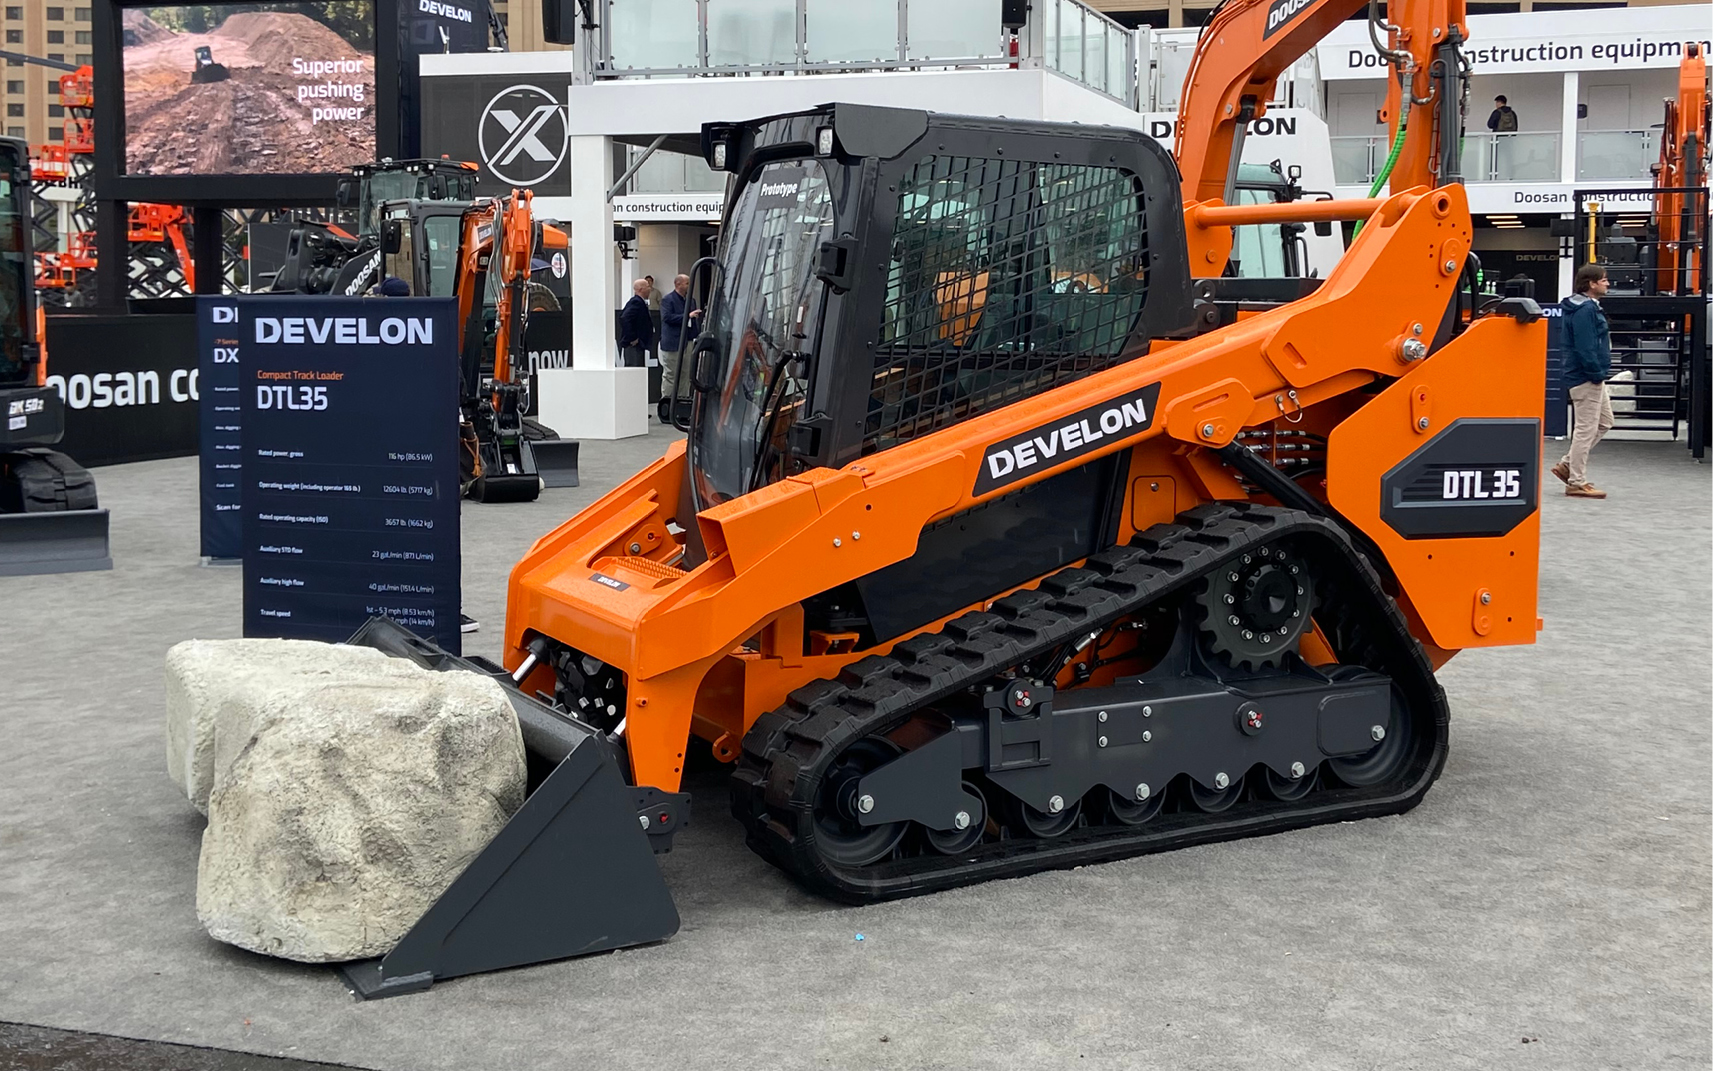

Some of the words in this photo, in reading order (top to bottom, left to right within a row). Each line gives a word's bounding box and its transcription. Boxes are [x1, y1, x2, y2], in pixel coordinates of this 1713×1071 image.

[419, 0, 472, 23] DEVELON
[1464, 42, 1583, 64] nstruction
[292, 56, 364, 78] Superior
[297, 81, 364, 102] pushing
[312, 107, 365, 125] power
[760, 182, 798, 198] Prototype
[1515, 191, 1567, 203] Doosan
[626, 202, 693, 213] construction
[255, 317, 433, 344] DEVELON
[528, 350, 569, 375] now
[257, 370, 291, 381] Compact
[293, 370, 315, 380] Track
[316, 371, 344, 380] Loader
[46, 370, 160, 410] oosan
[257, 385, 328, 411] DTL35
[987, 398, 1147, 480] DEVELON
[388, 452, 397, 460] 116
[397, 453, 405, 461] hp
[405, 453, 421, 462] (86.5
[421, 453, 433, 462] kW)
[258, 481, 283, 490] Operating
[283, 482, 300, 490] weight
[300, 482, 323, 492] (including
[383, 485, 400, 493] 12604
[408, 485, 423, 494] (5717
[423, 487, 433, 496] kg)
[273, 515, 296, 523] operating
[385, 518, 399, 526] 3657
[407, 519, 423, 527] (1662
[423, 520, 434, 529] kg)
[259, 545, 281, 554] Auxiliary
[371, 550, 380, 558] 23
[415, 552, 434, 561] L/min)
[259, 577, 281, 586] Auxiliary
[281, 578, 293, 587] high
[415, 585, 435, 594] L/min)
[379, 606, 388, 614] 5.3
[388, 608, 401, 616] mph
[402, 607, 417, 616] (8.53
[417, 609, 435, 617] km/h)
[408, 617, 417, 626] (14
[417, 618, 435, 627] km/h)
